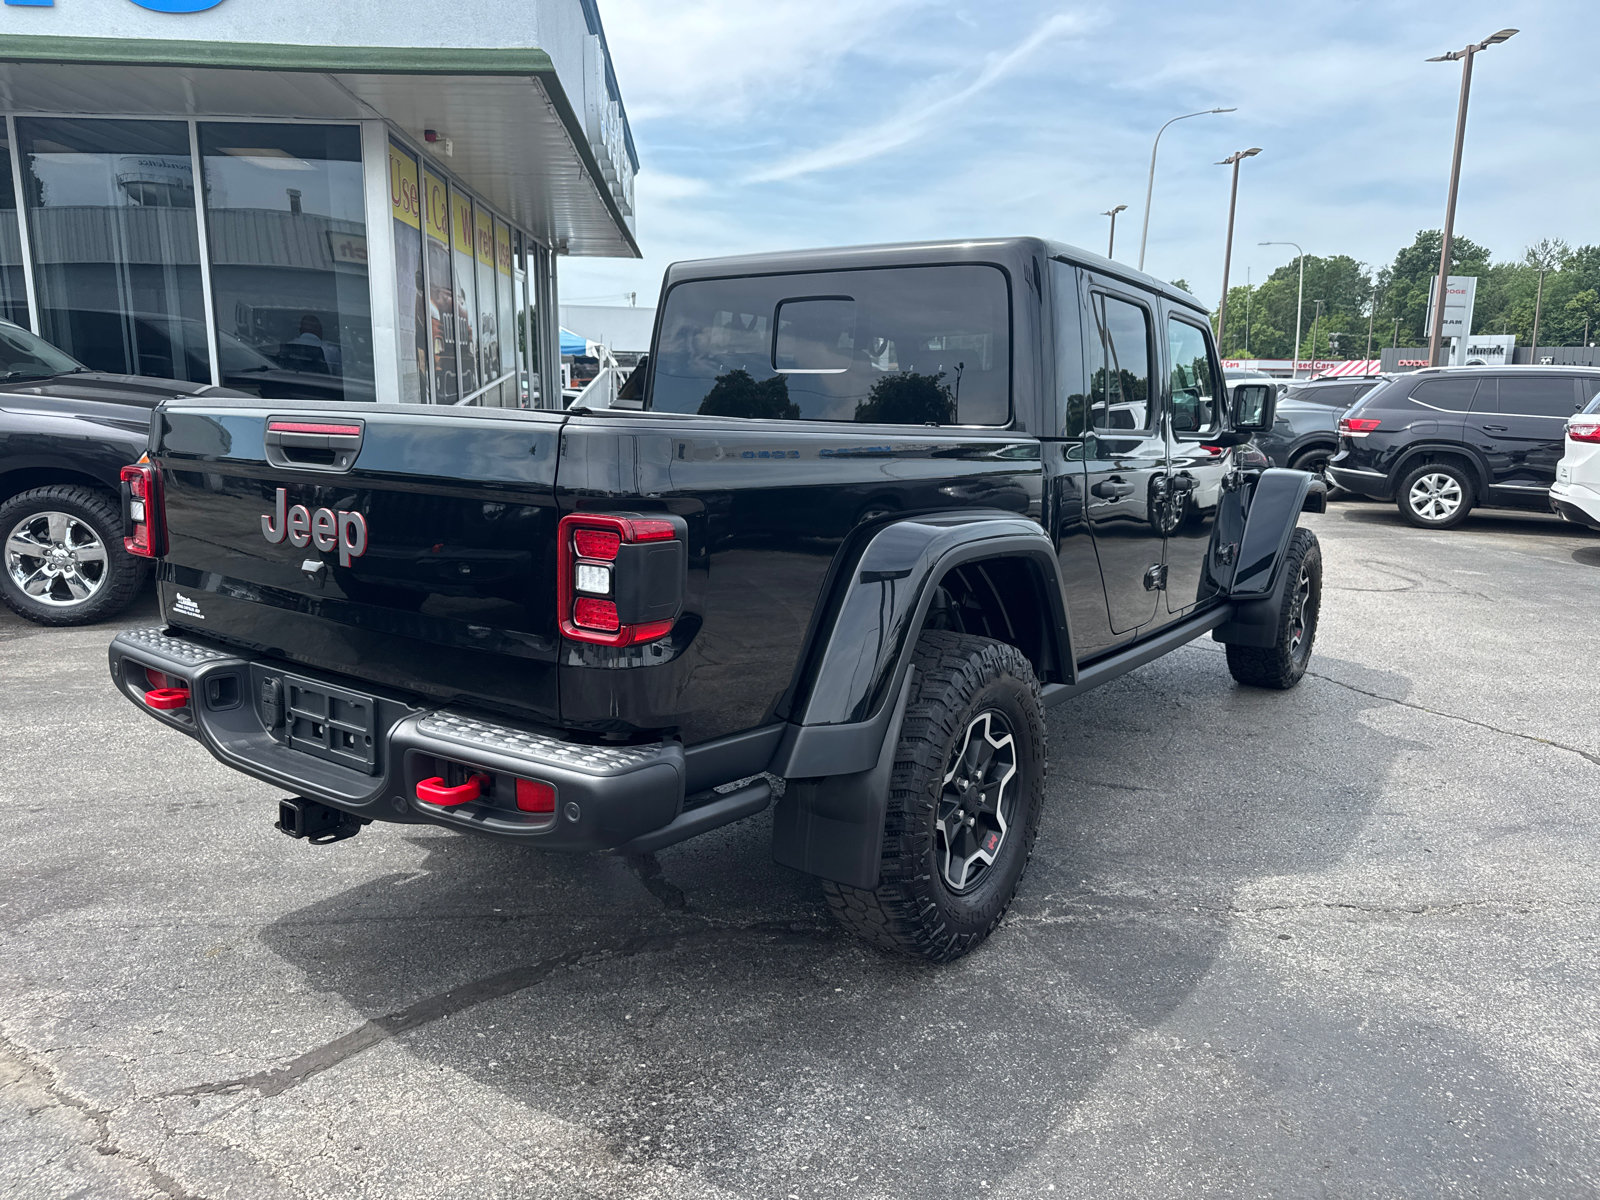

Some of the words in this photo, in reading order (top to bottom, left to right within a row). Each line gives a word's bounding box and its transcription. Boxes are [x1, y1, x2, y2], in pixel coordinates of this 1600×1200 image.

[460, 203, 510, 270] Wrehuse
[1451, 344, 1505, 356] Ldmark
[1315, 361, 1335, 369] Cars
[1397, 359, 1430, 367] DODG
[261, 487, 368, 569] Jeep
